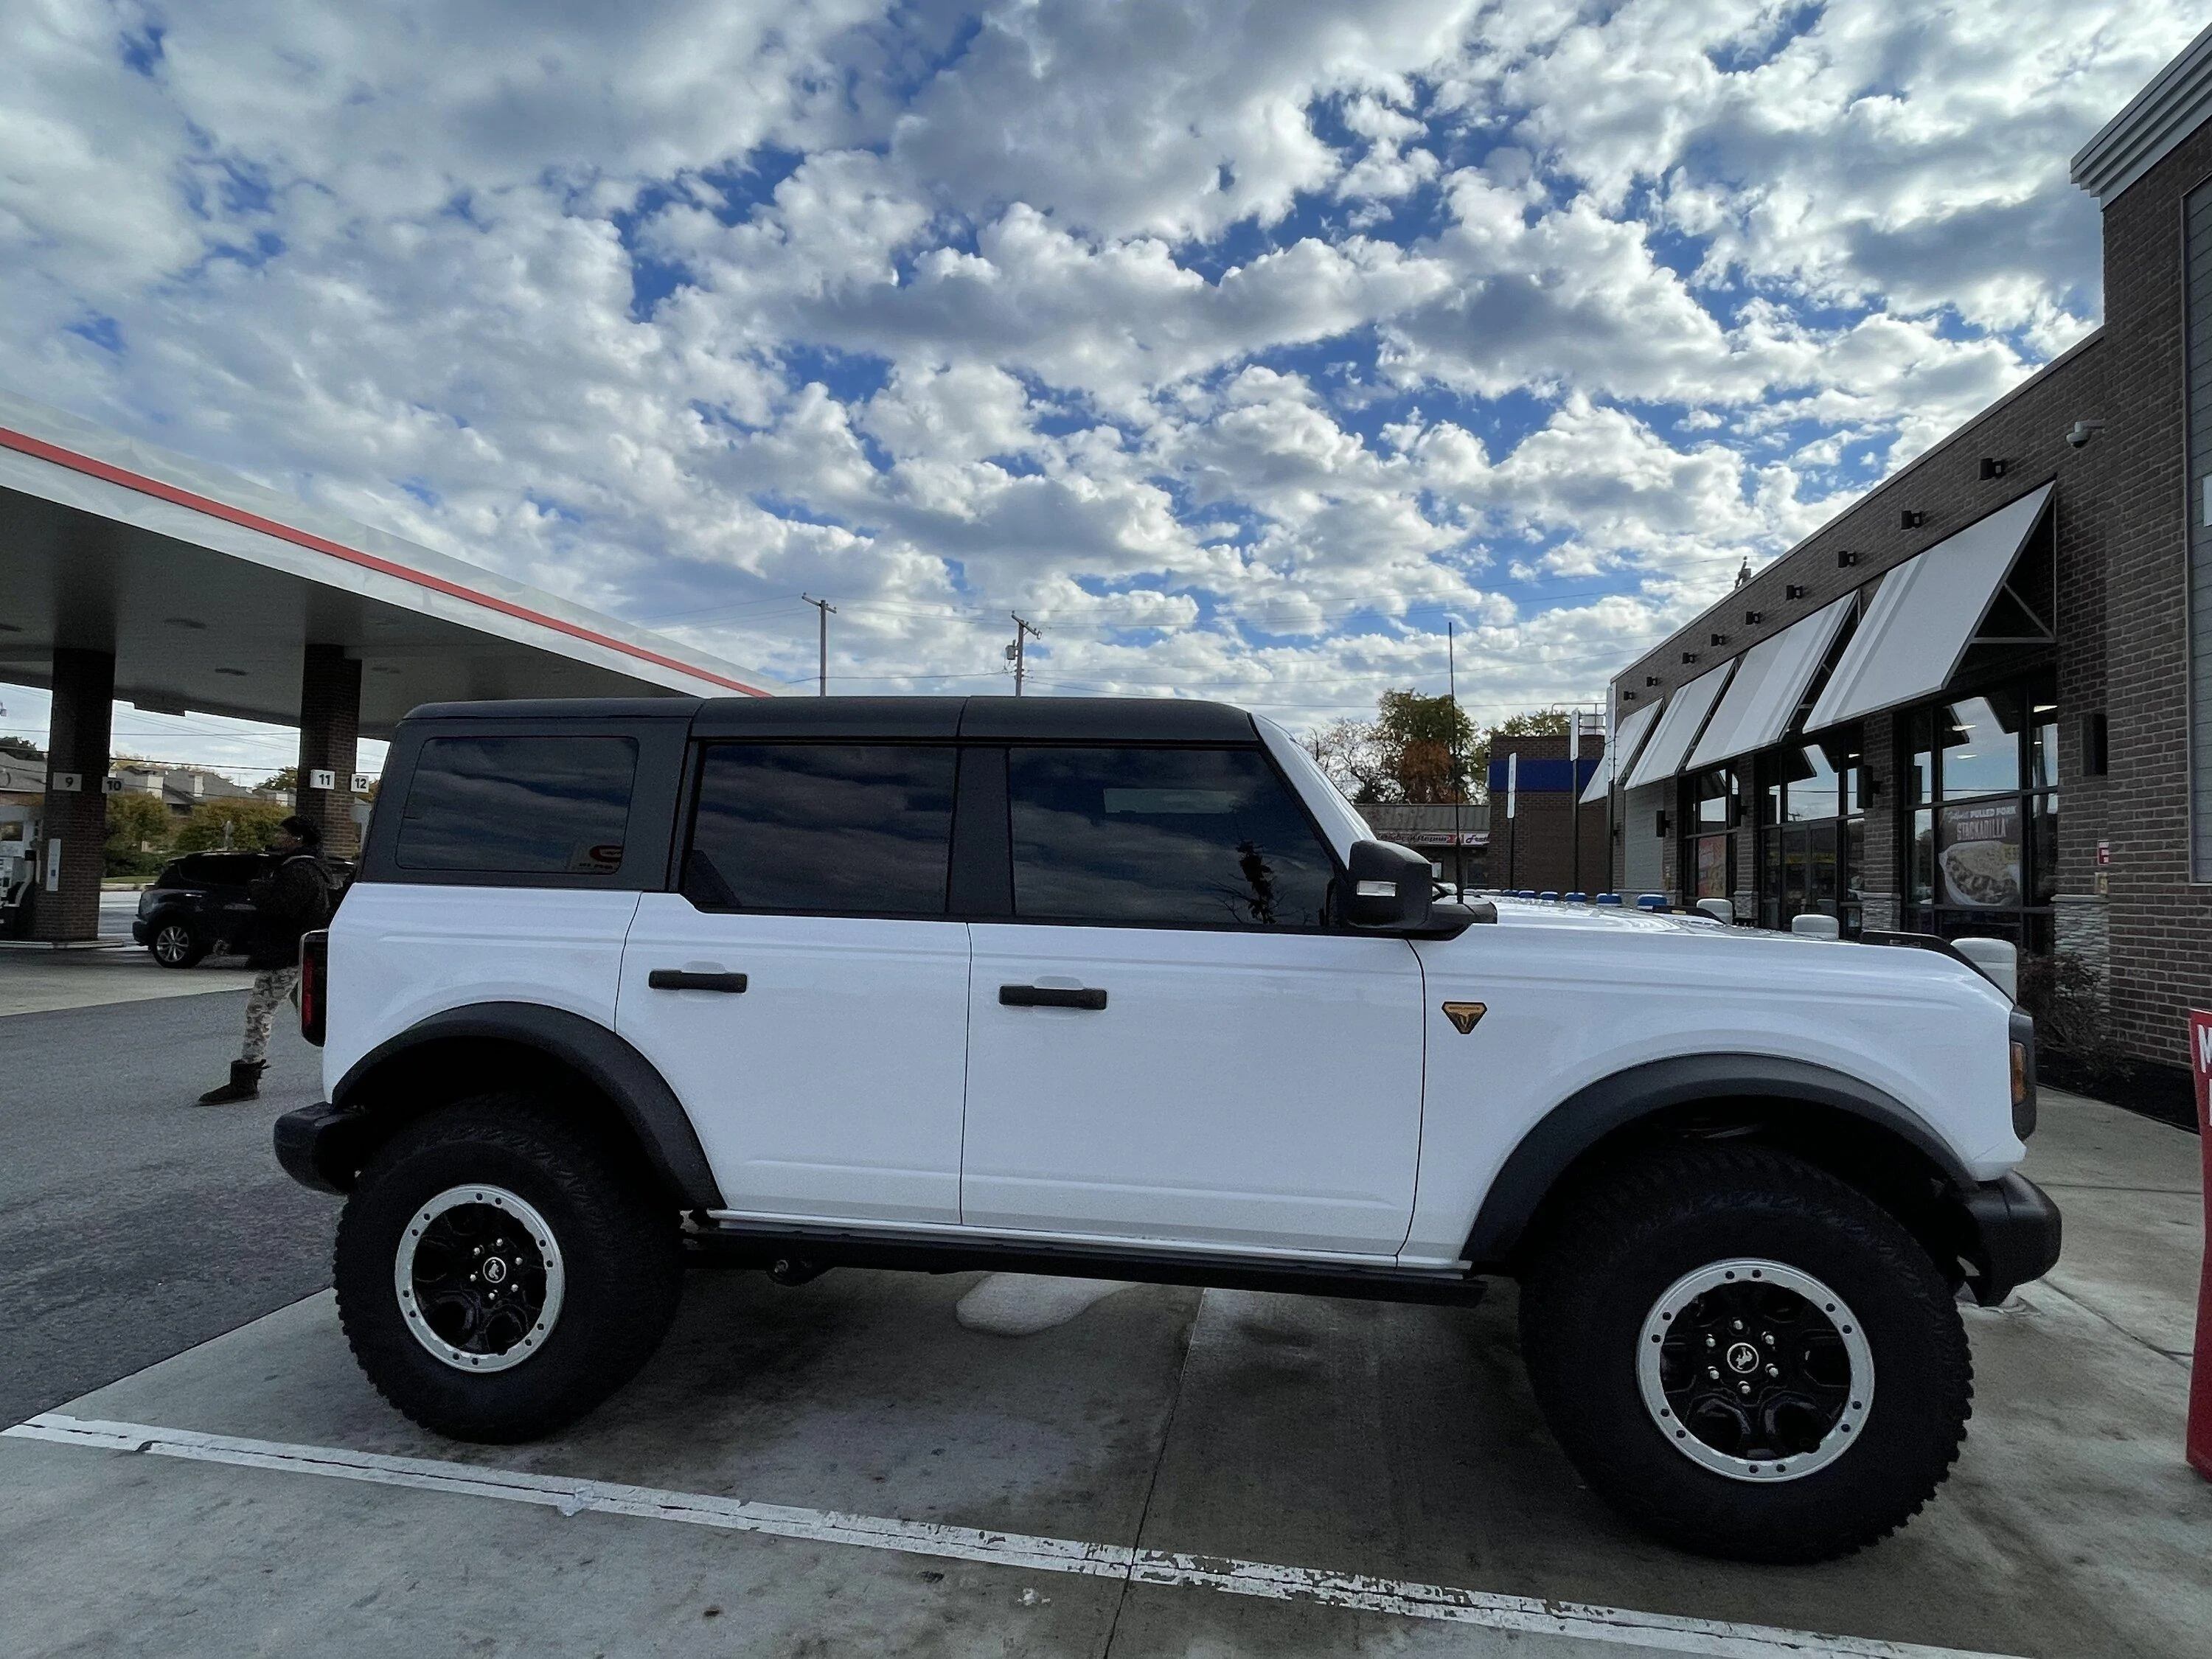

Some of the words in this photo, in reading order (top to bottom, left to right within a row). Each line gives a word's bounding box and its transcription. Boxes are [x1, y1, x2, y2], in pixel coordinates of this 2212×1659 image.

[65, 776, 74, 787] 9
[319, 773, 330, 785] 11
[355, 778, 366, 789] 12
[107, 780, 122, 791] 10
[1969, 808, 1995, 818] PULLED
[1996, 805, 2017, 816] PORK
